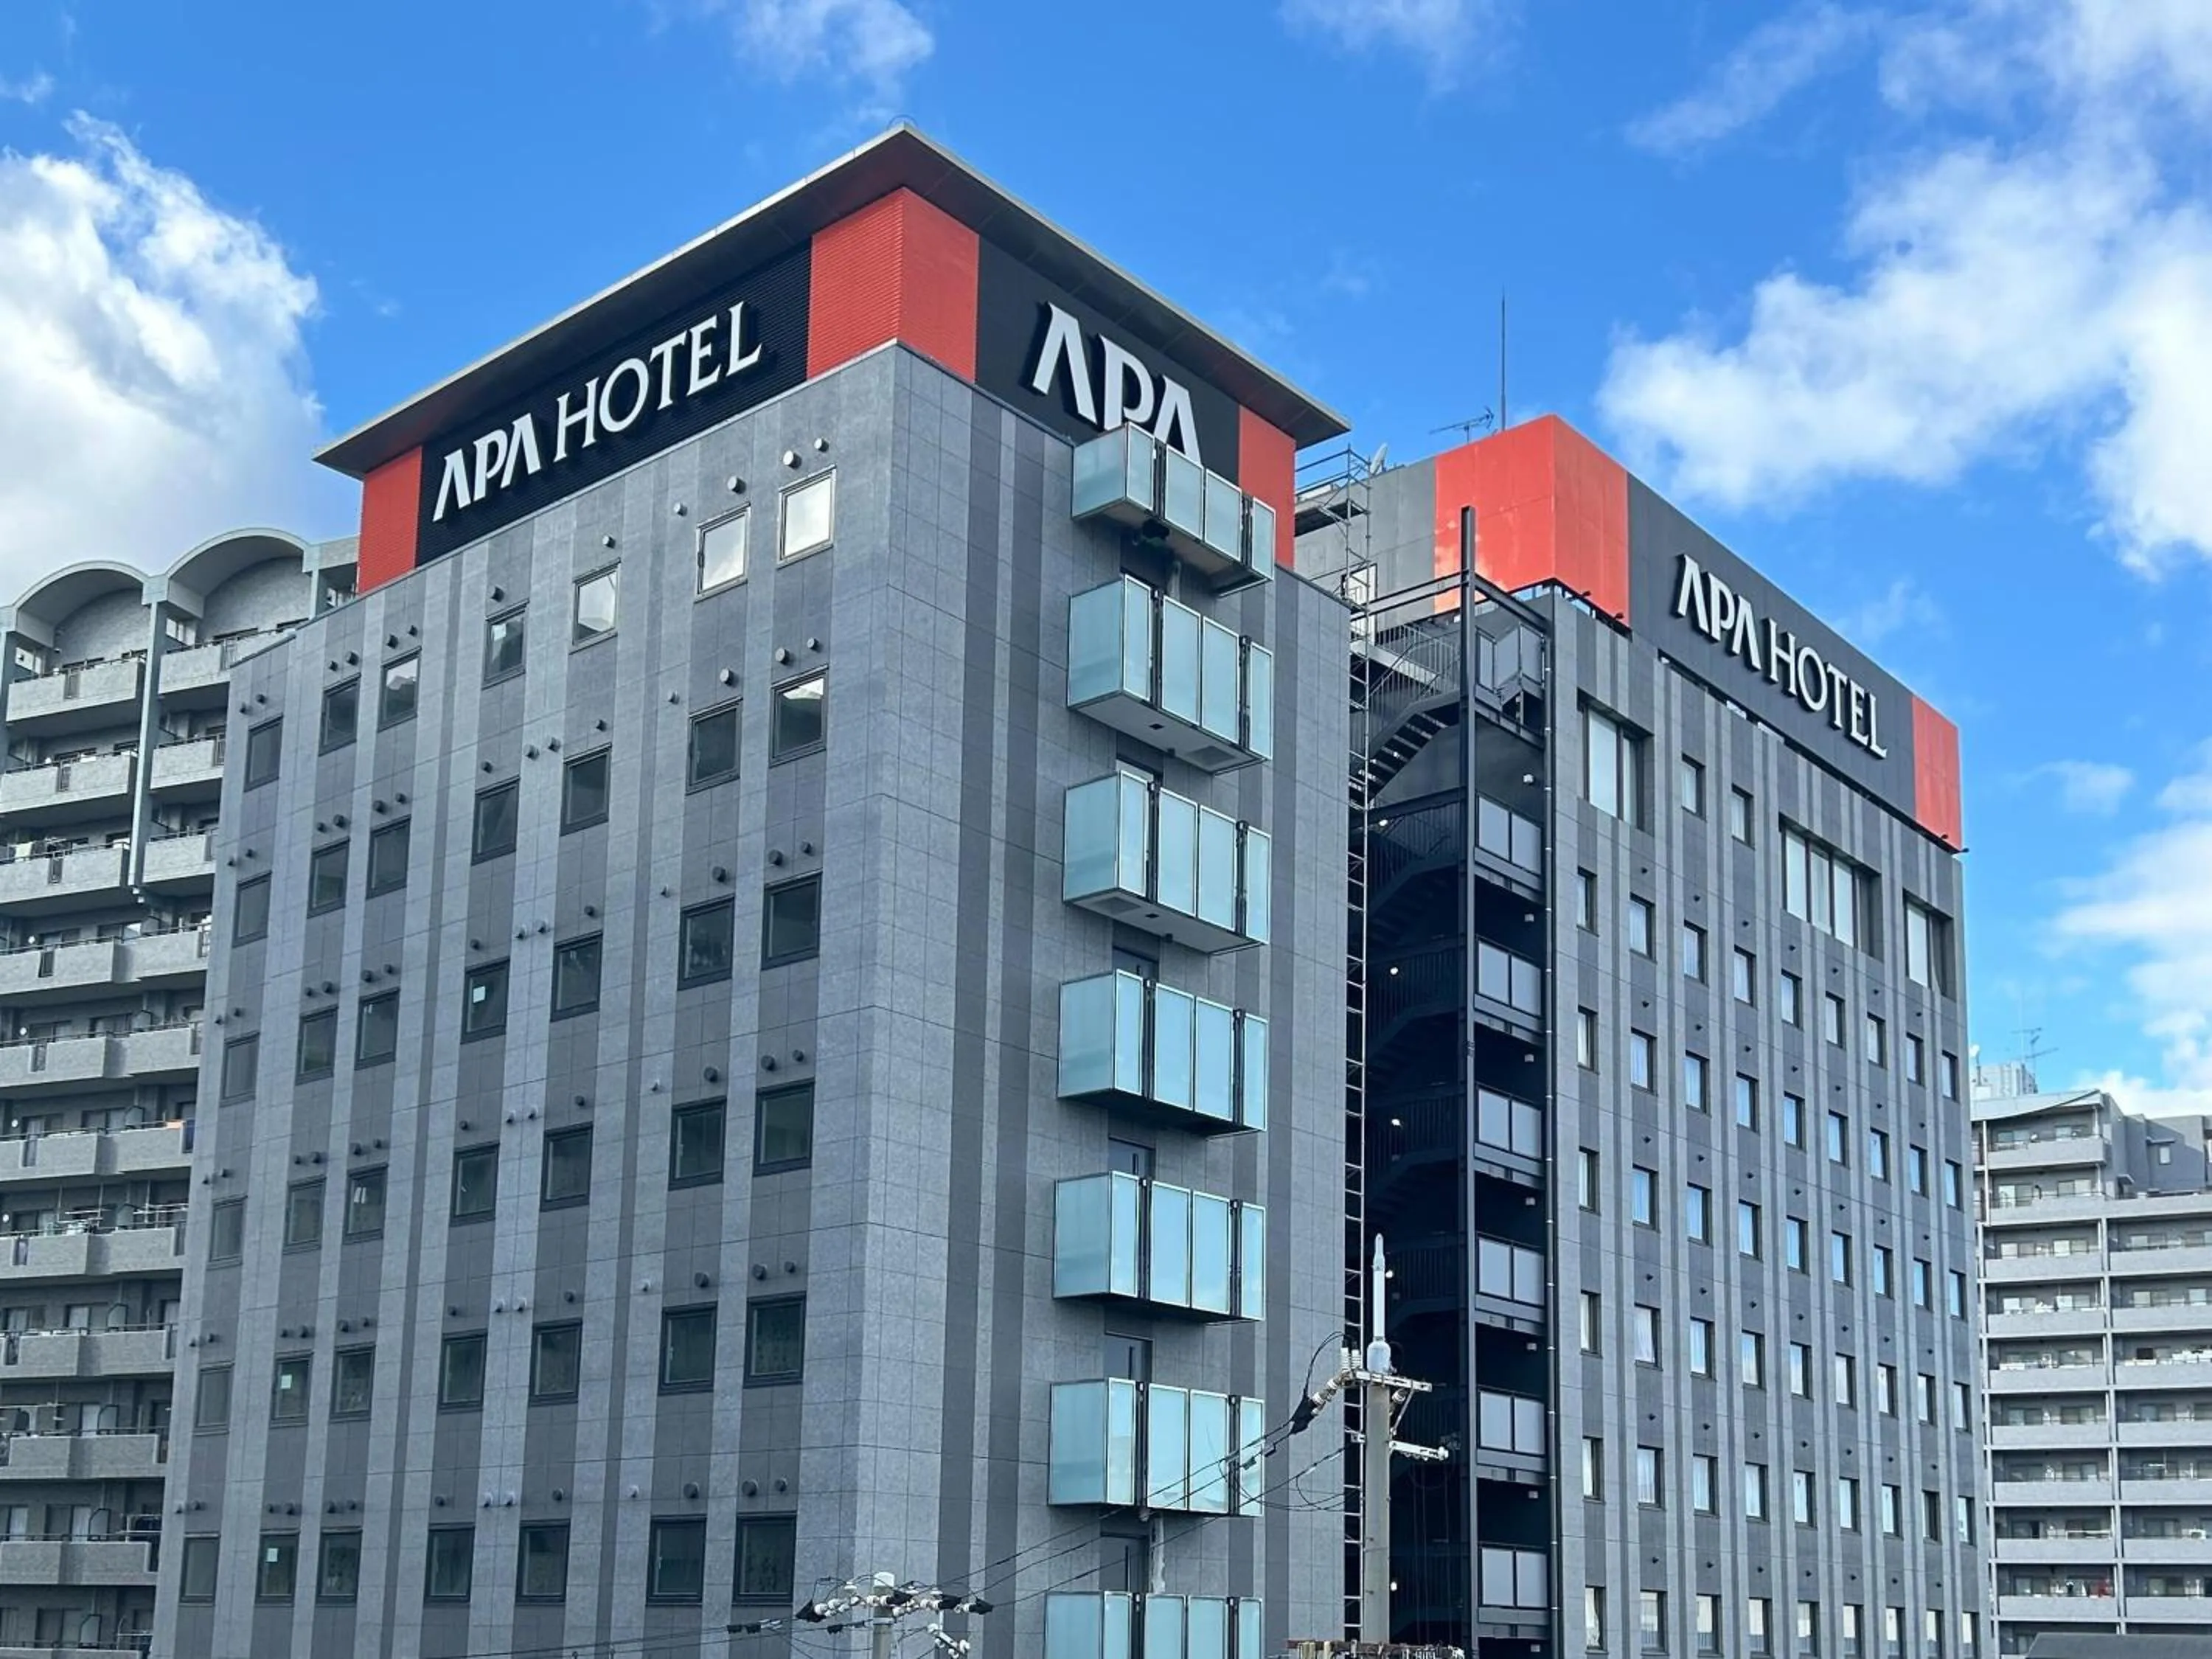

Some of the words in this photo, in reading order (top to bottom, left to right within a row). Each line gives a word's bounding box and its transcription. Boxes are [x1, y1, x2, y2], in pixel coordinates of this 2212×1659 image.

[433, 412, 542, 522] APA
[554, 301, 762, 463] HOTEL
[1032, 301, 1202, 465] APA
[1677, 554, 1761, 670] APA
[1770, 618, 1888, 759] HOTEL
